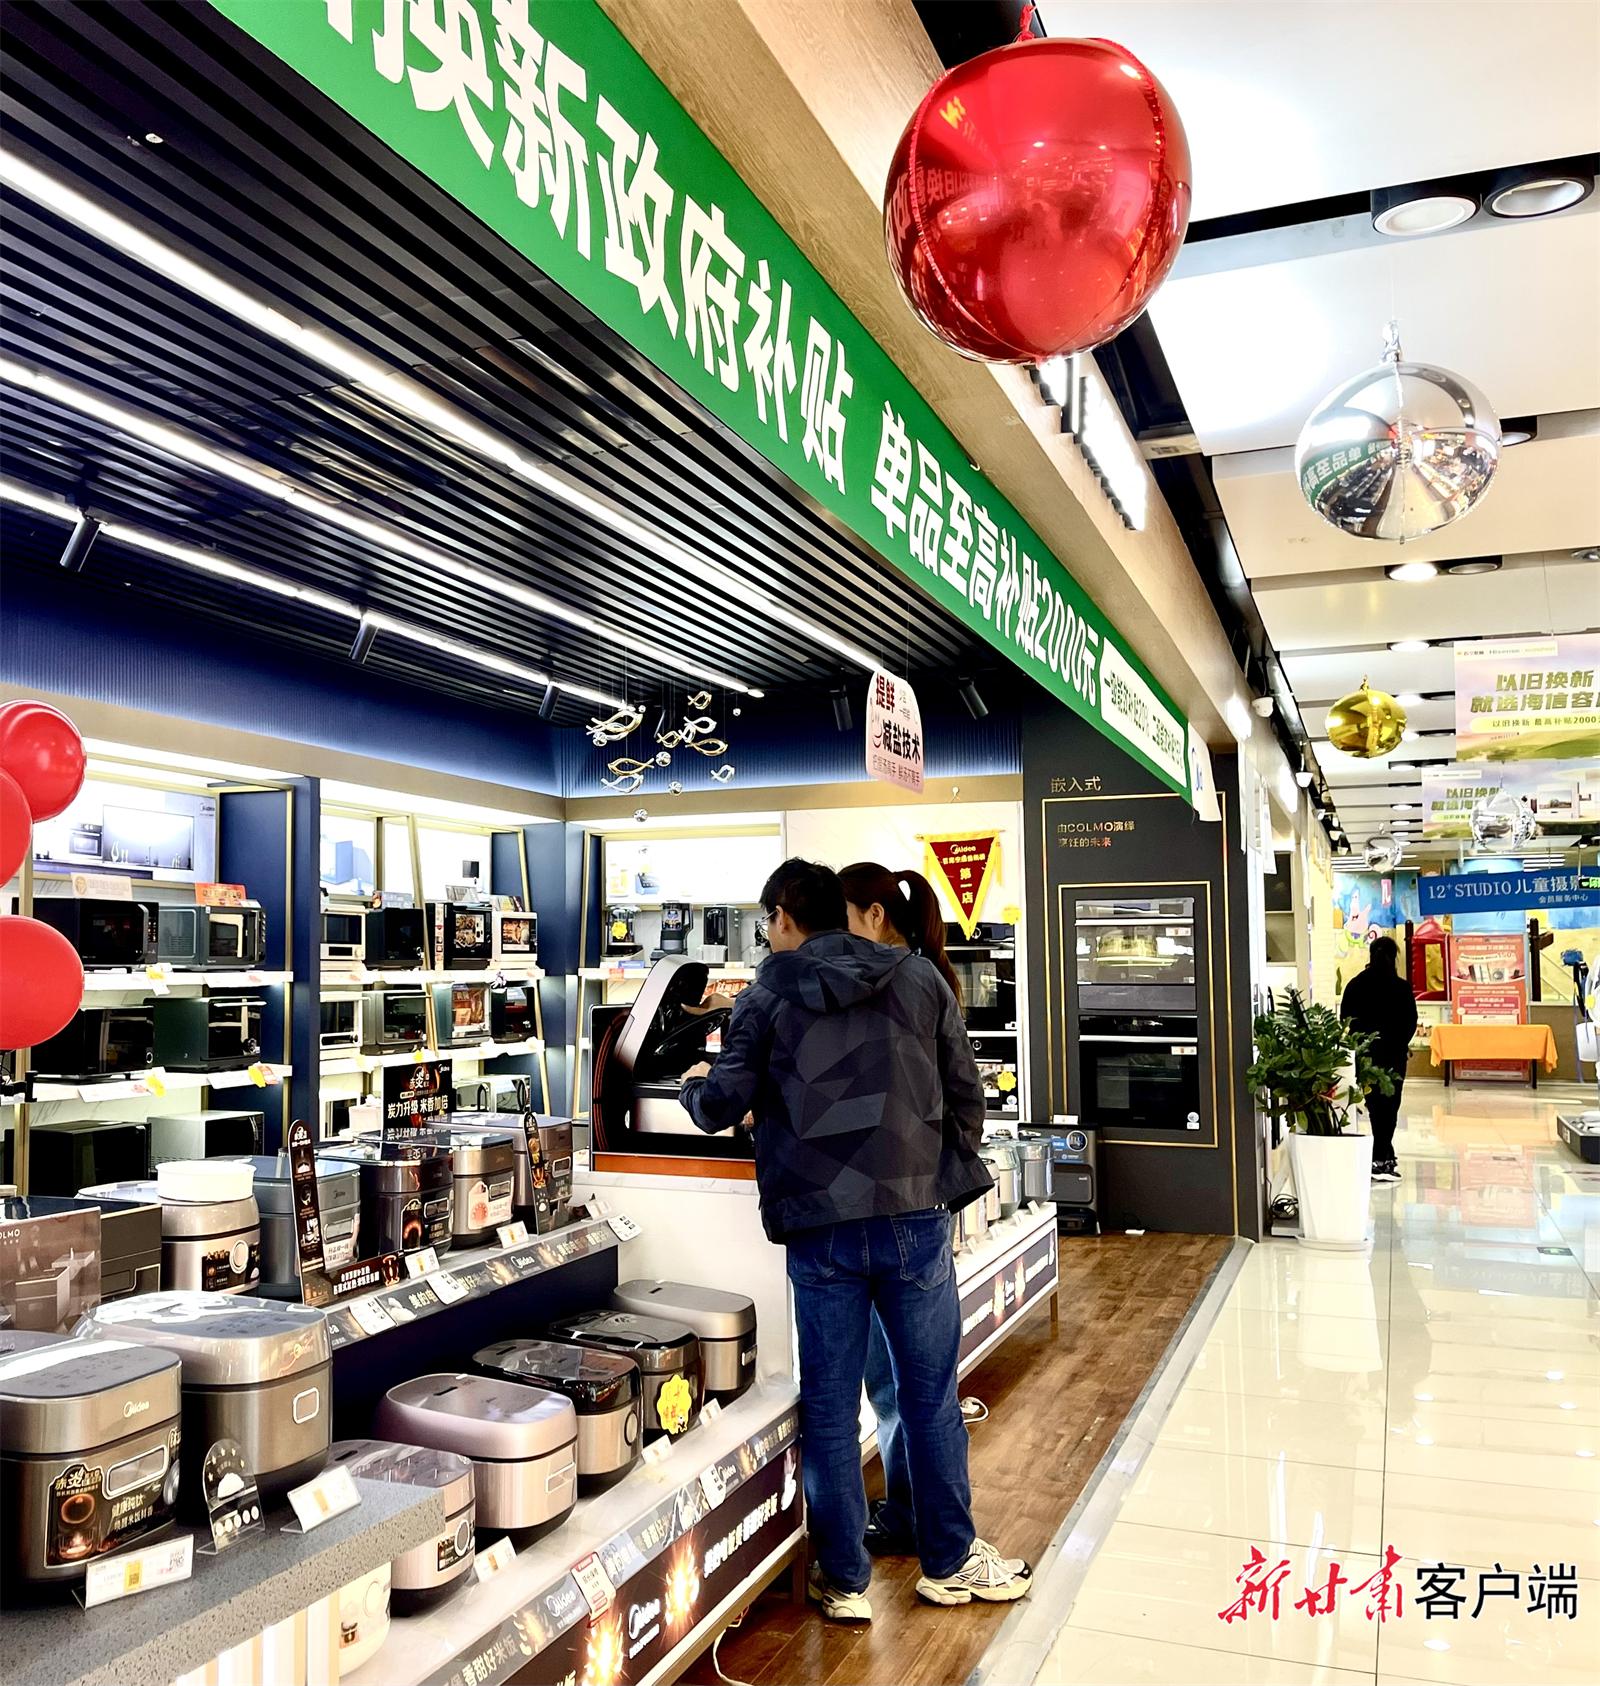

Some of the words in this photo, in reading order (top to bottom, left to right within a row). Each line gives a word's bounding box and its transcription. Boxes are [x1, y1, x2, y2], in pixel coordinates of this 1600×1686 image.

[326, 0, 855, 496] 换新政府补贴
[870, 399, 1099, 708] 单品至高补贴2000元
[1496, 669, 1594, 692] 以旧换新
[1470, 691, 1600, 713] 就选海信容
[882, 719, 921, 765] 减盐技术
[1051, 776, 1102, 793] 嵌入式
[1057, 820, 1136, 834] 由COLMO演绎
[1058, 837, 1112, 848] 烹饪的未来
[1454, 882, 1512, 897] STUDIO
[387, 1099, 418, 1119] 炭力升级
[123, 1400, 150, 1418] Midea
[546, 1590, 577, 1618] Midea
[628, 1598, 661, 1640] Midea
